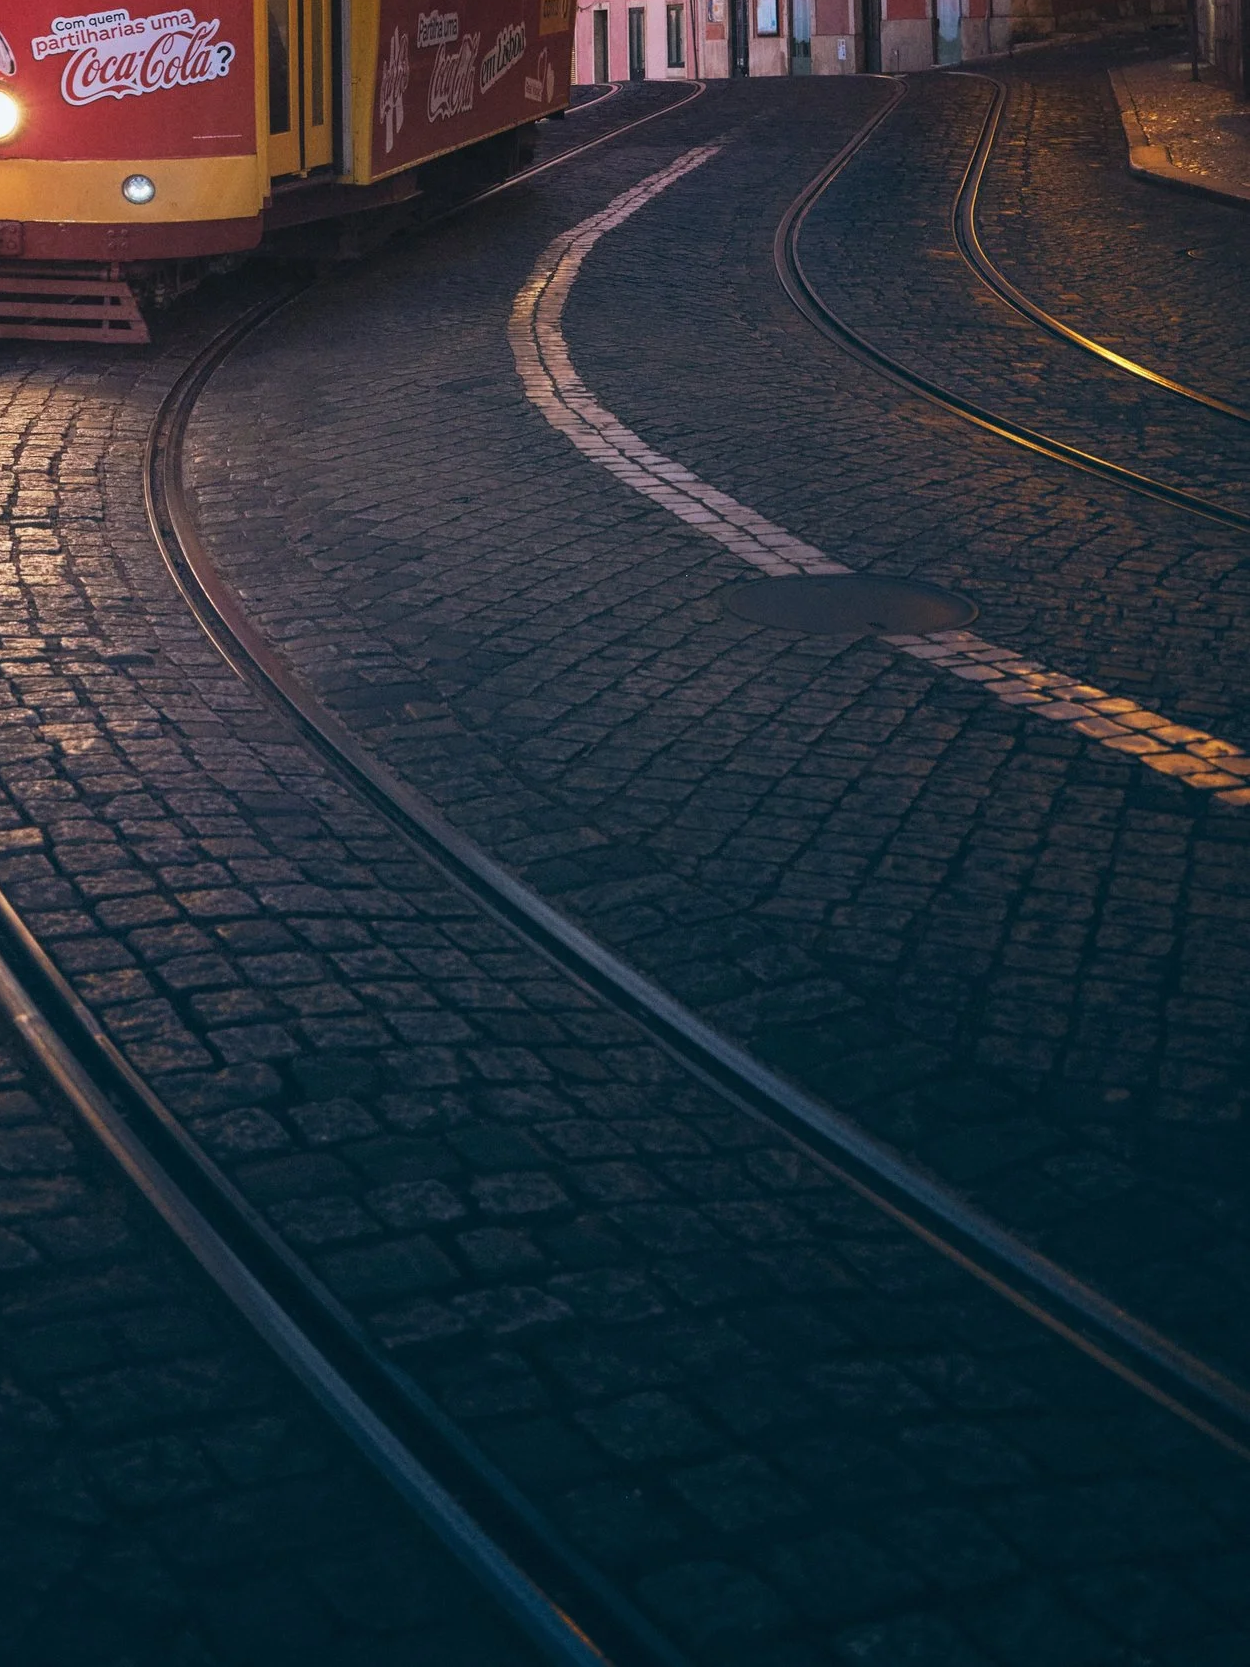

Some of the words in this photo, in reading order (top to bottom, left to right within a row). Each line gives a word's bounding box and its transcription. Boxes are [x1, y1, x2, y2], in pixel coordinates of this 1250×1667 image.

[35, 21, 145, 55] partilharias
[150, 13, 191, 31] uma
[55, 19, 85, 32] Com
[88, 11, 126, 28] quem
[481, 54, 496, 88] em
[497, 27, 525, 71] Lisboa
